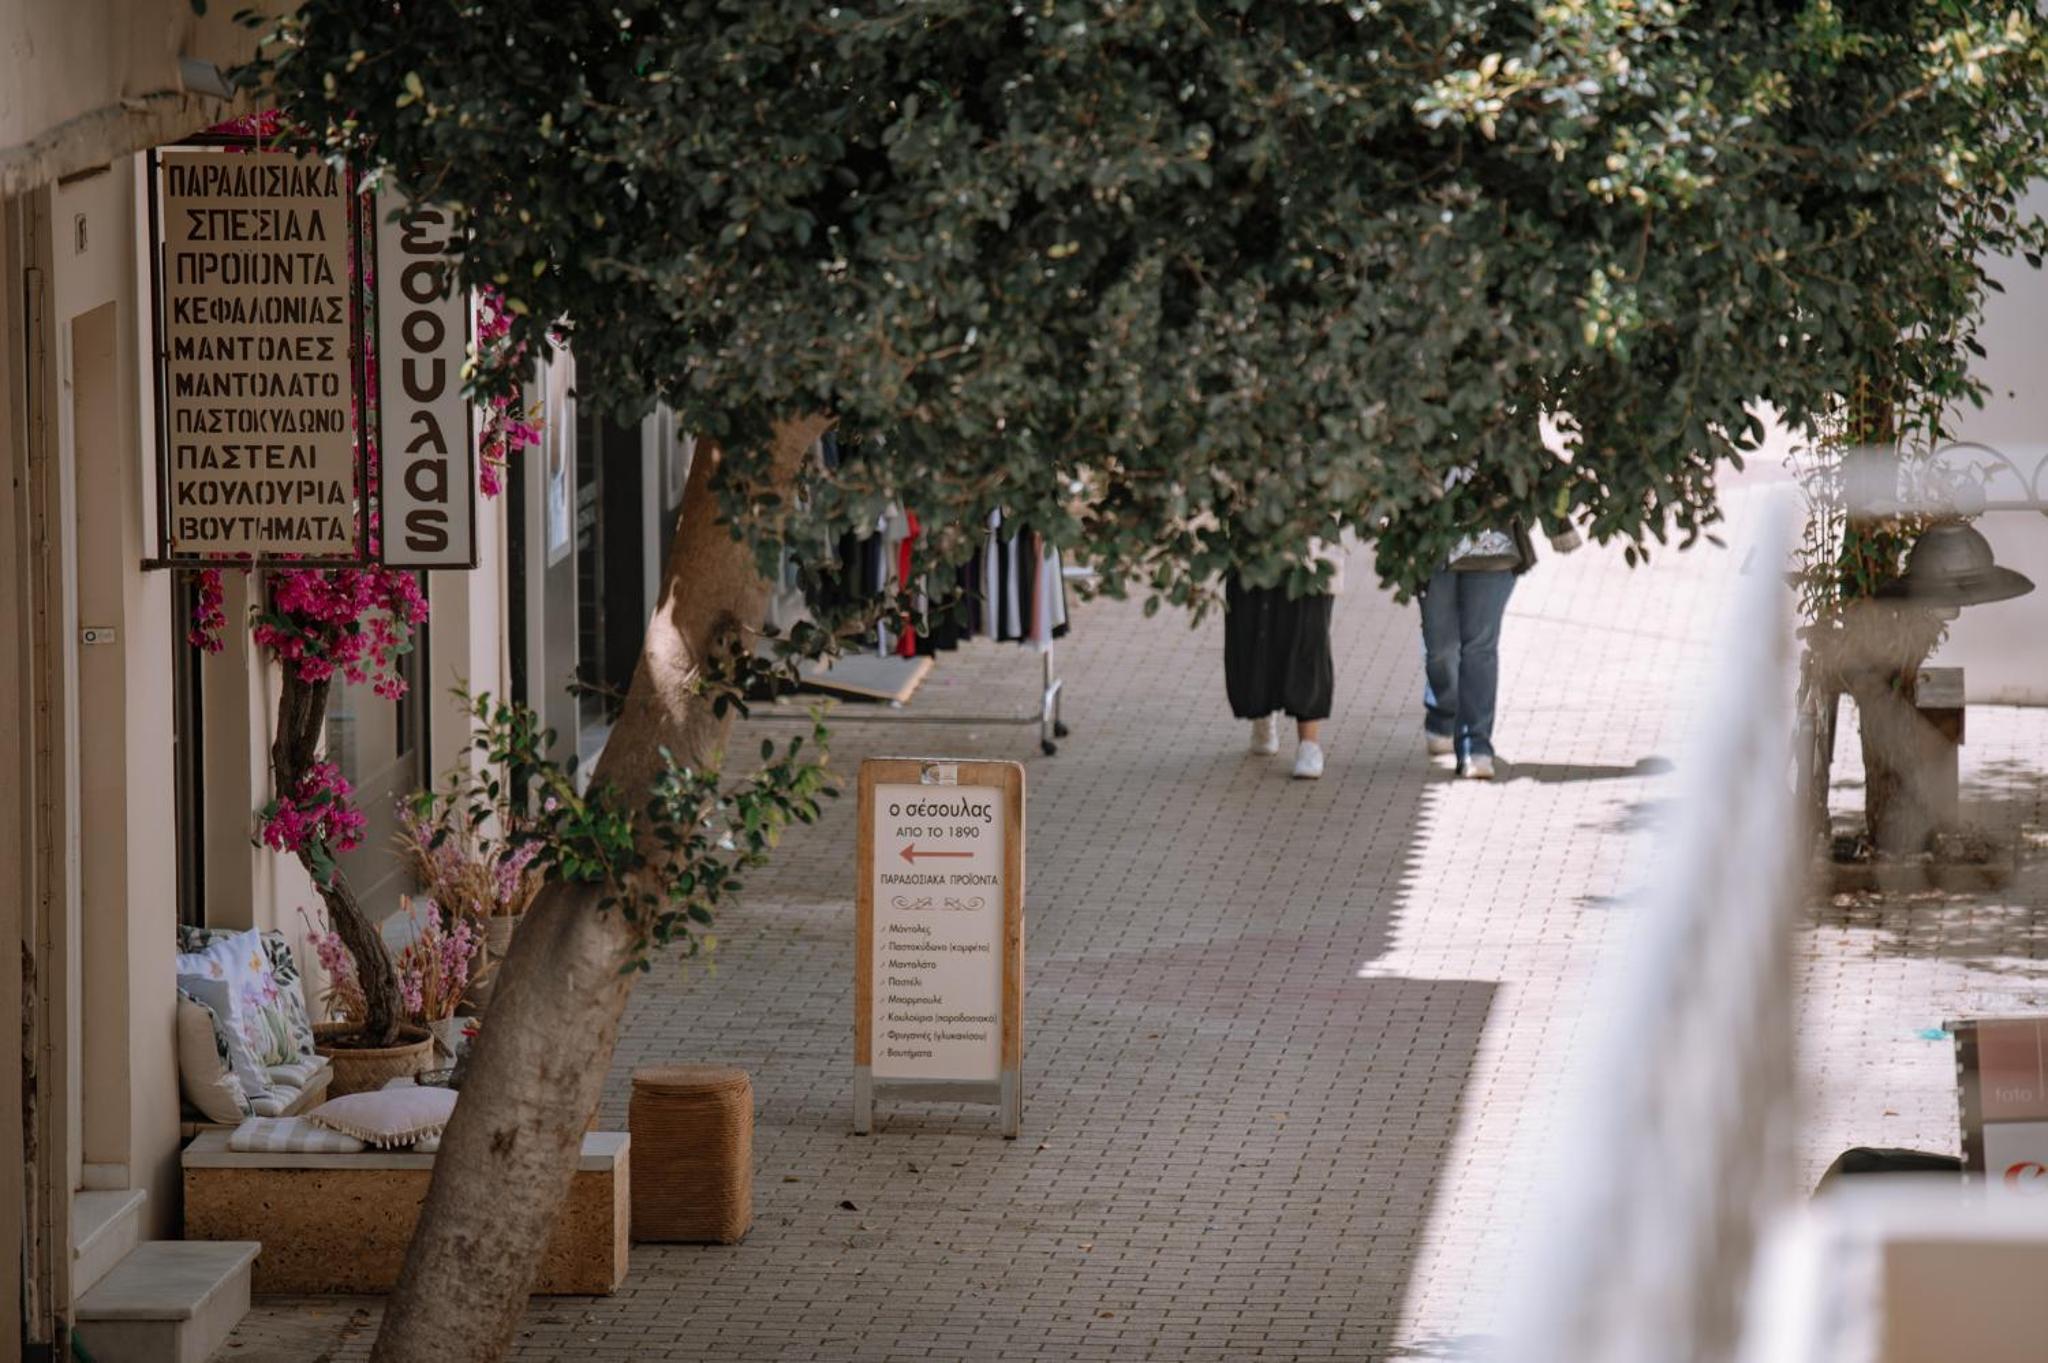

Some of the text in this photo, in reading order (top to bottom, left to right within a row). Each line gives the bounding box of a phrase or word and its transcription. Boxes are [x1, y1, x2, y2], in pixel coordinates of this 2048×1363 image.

[169, 165, 339, 197] ΠΑΡΑΔΟΣΙΑΚΑ
[186, 209, 326, 241] ΣΠΕΣΙΑΛ
[174, 296, 343, 324] ΚΕΦΑΛΟΝΙΑΣ
[174, 337, 334, 361] ΜΑΝΤΟΛΕΣ
[175, 372, 339, 397] ΜΑΝΤΟΛΑΤΟ
[176, 408, 345, 433] ΠΑΣΤΟΚΥΔΩΝΟ
[177, 445, 317, 469] ΠΑΣΤΕΛΙ
[178, 481, 346, 505] ΚΟΥΛΟΥΡΙΑ
[179, 517, 346, 541] ΒΟΥΤΗΜΑΤΑ
[906, 797, 993, 823] σέσουλας
[896, 826, 980, 838] ΑΠΟ ΤΟ 1890
[880, 873, 946, 886] ΠΑΡΑΔΟΣΙΑΚΑ
